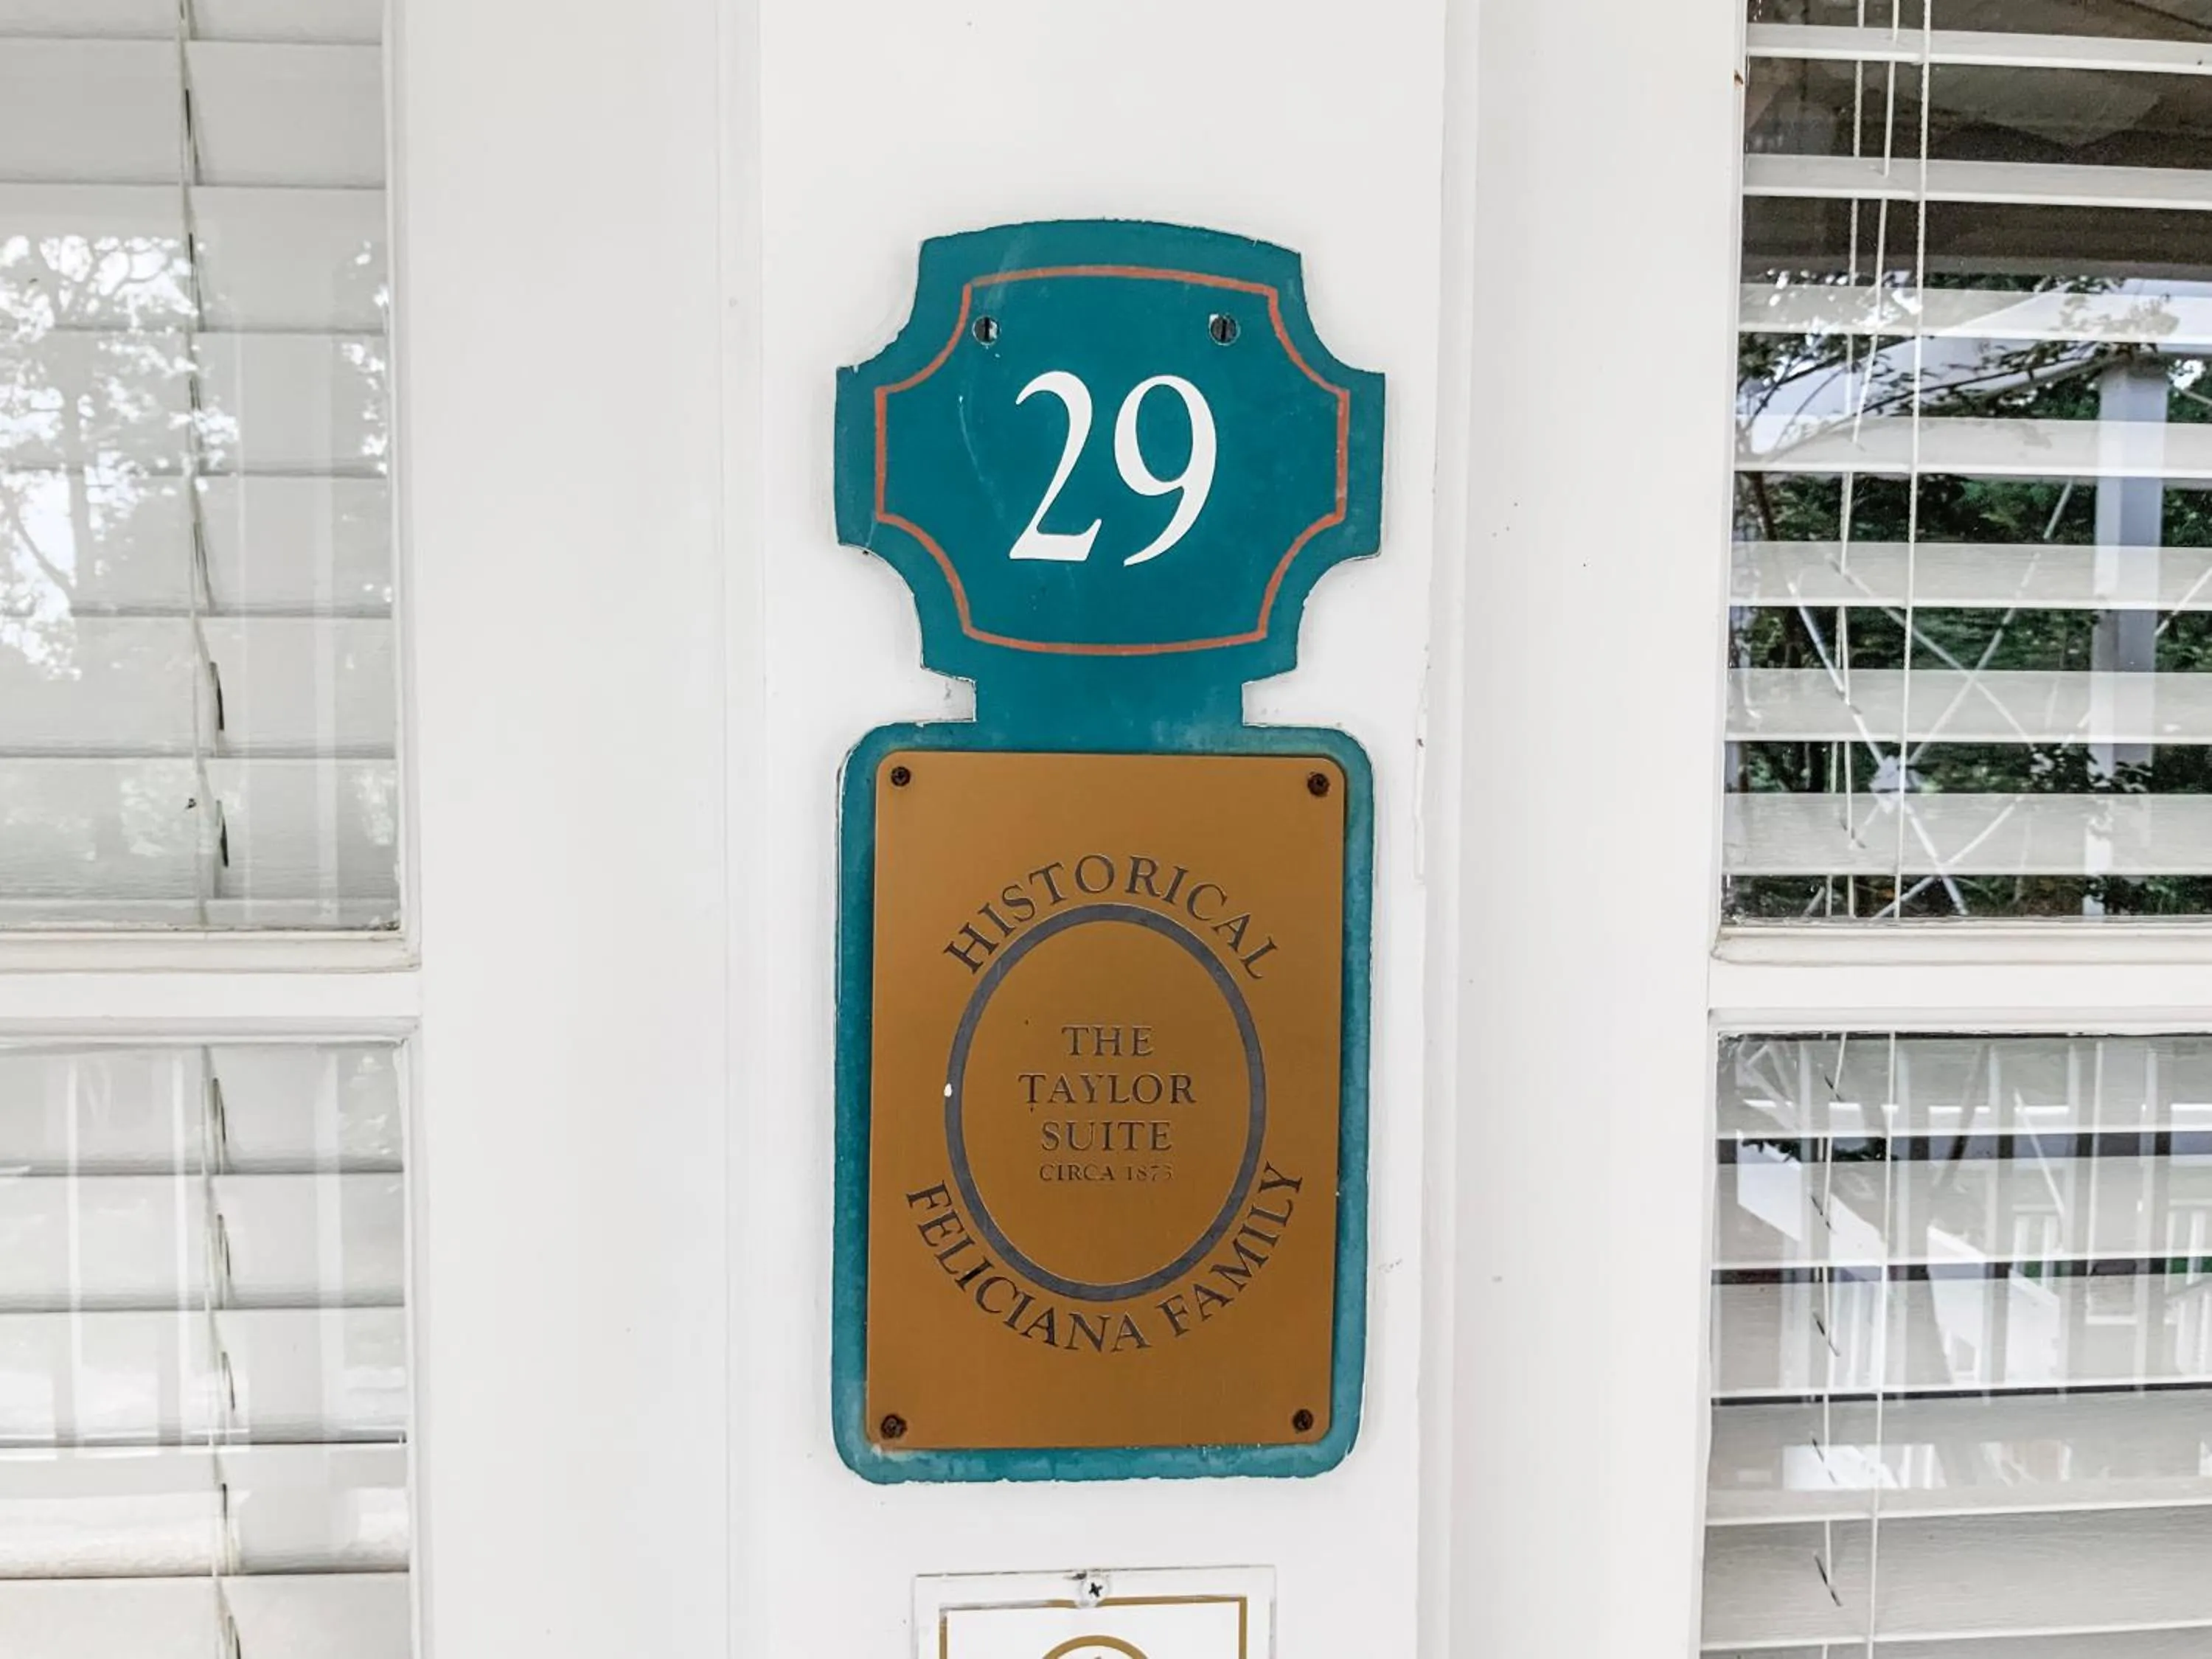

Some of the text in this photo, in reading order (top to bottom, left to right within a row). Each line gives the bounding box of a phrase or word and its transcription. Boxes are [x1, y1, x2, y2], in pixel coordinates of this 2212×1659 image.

[1009, 370, 1217, 566] 29
[943, 854, 1279, 980] HISTORICAL
[1061, 1025, 1155, 1057] THE
[1018, 1073, 1197, 1105] TAYLOR
[1040, 1120, 1173, 1152] SUITE
[1040, 1164, 1116, 1182] CIRCA
[906, 1161, 1304, 1354] FELICIANA FAMILY
